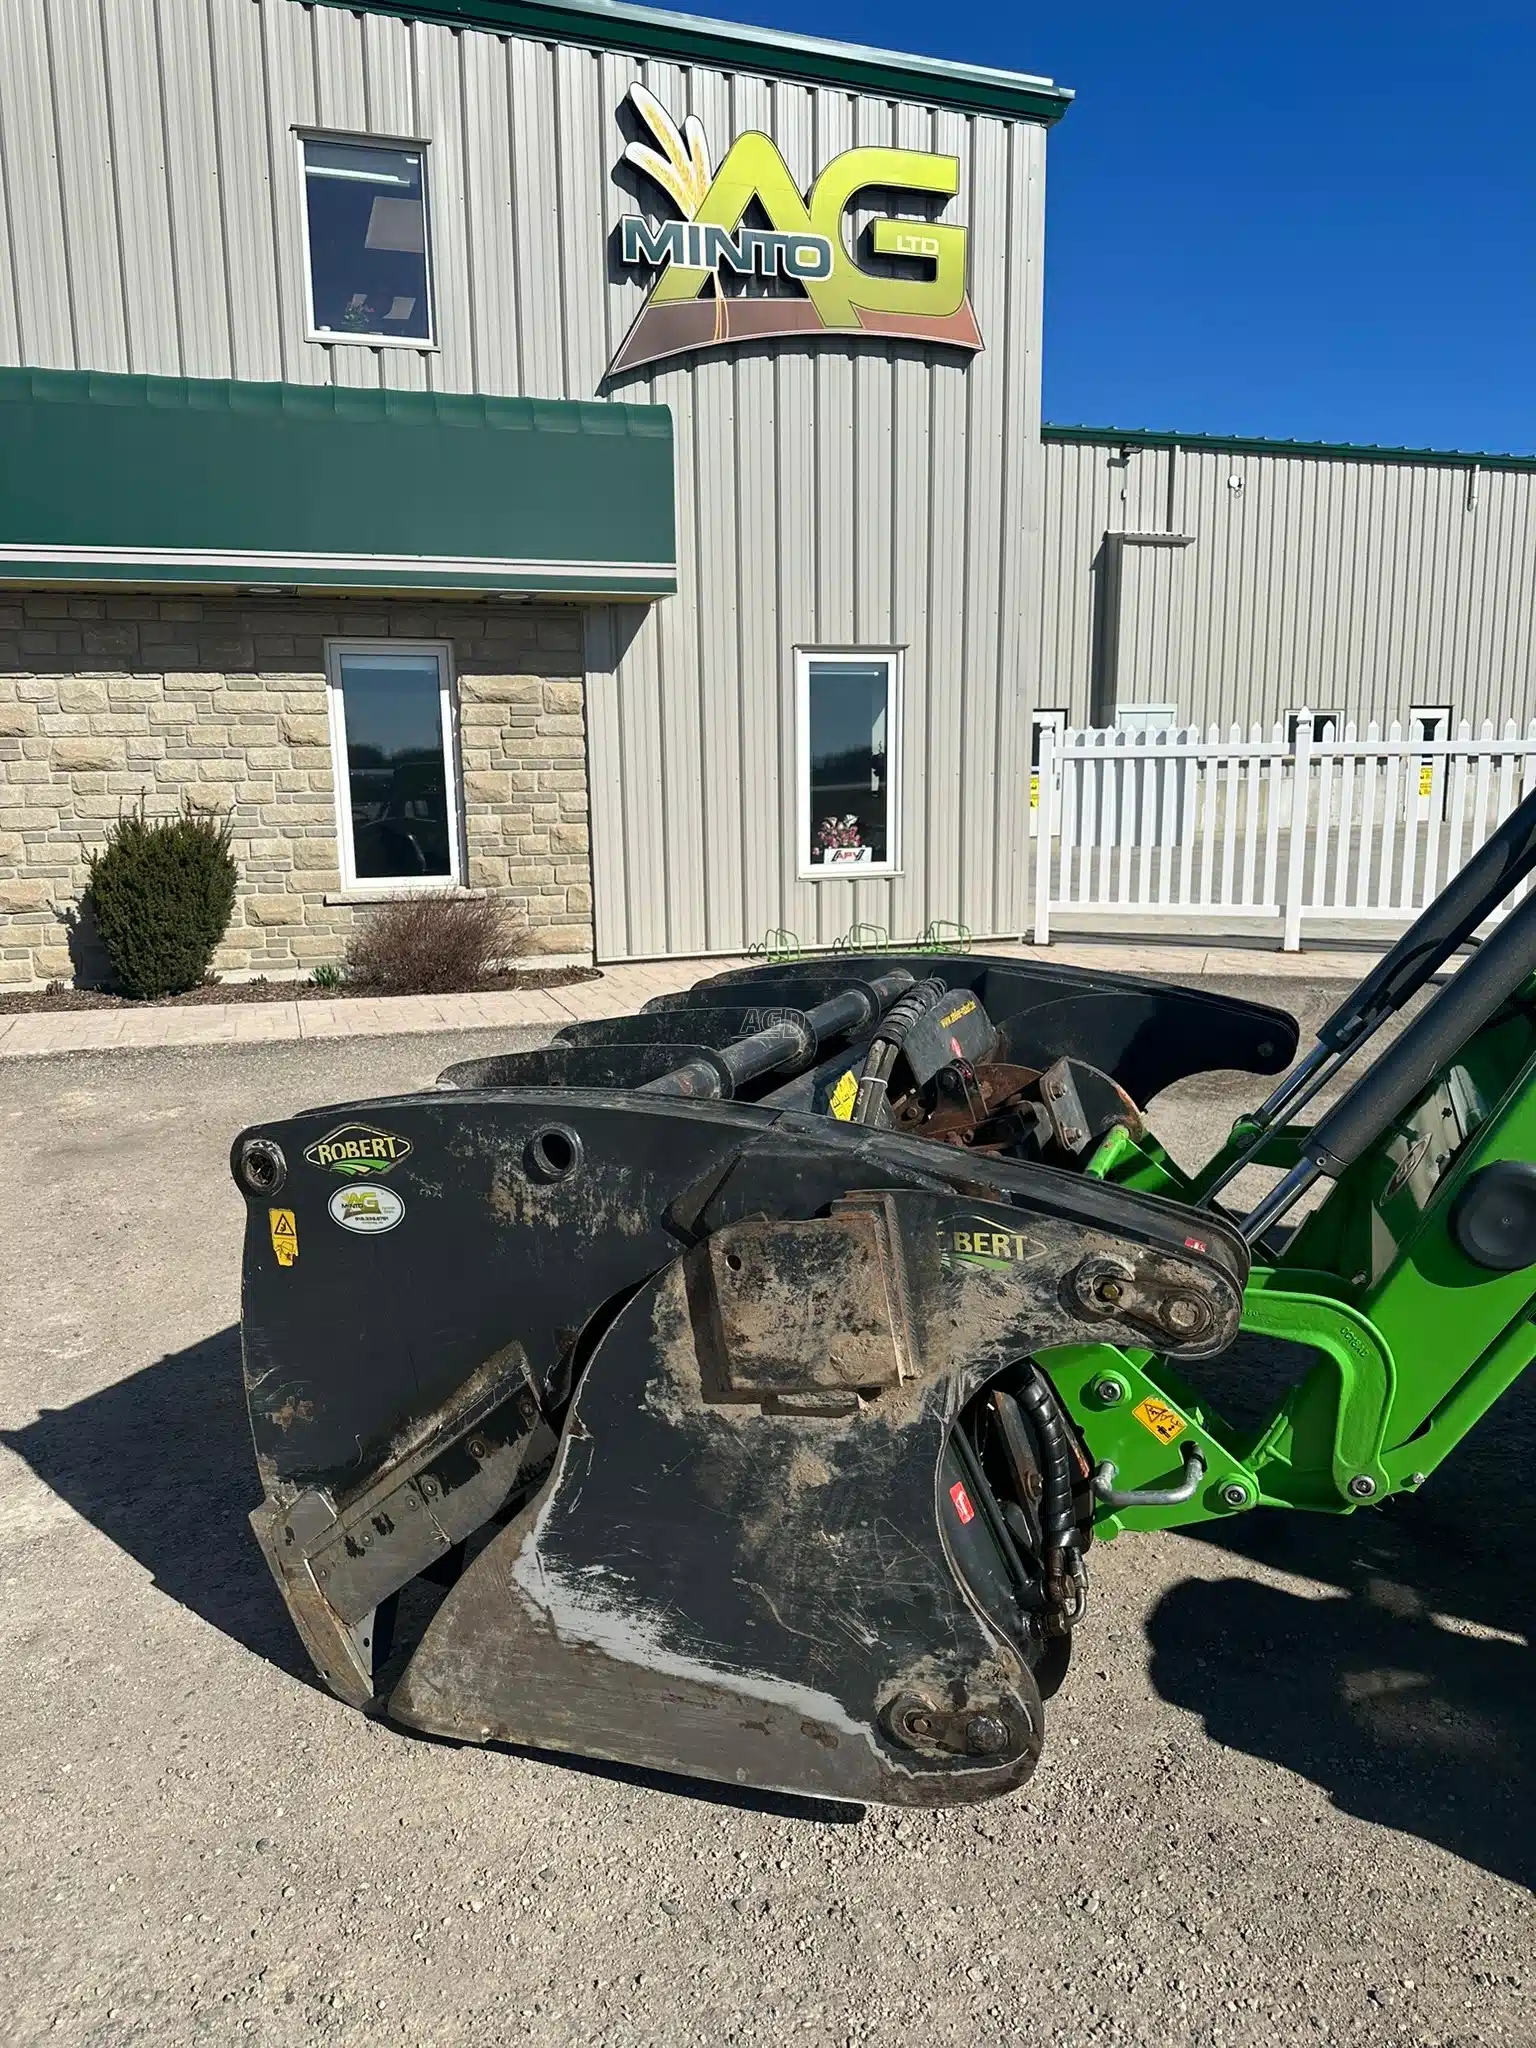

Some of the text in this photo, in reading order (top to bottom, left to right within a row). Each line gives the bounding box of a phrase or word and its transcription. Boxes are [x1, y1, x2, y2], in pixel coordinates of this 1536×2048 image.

[622, 130, 969, 328] MINTO AG LTD
[317, 1136, 396, 1165] ROBERT
[936, 1230, 1028, 1261] BERT
